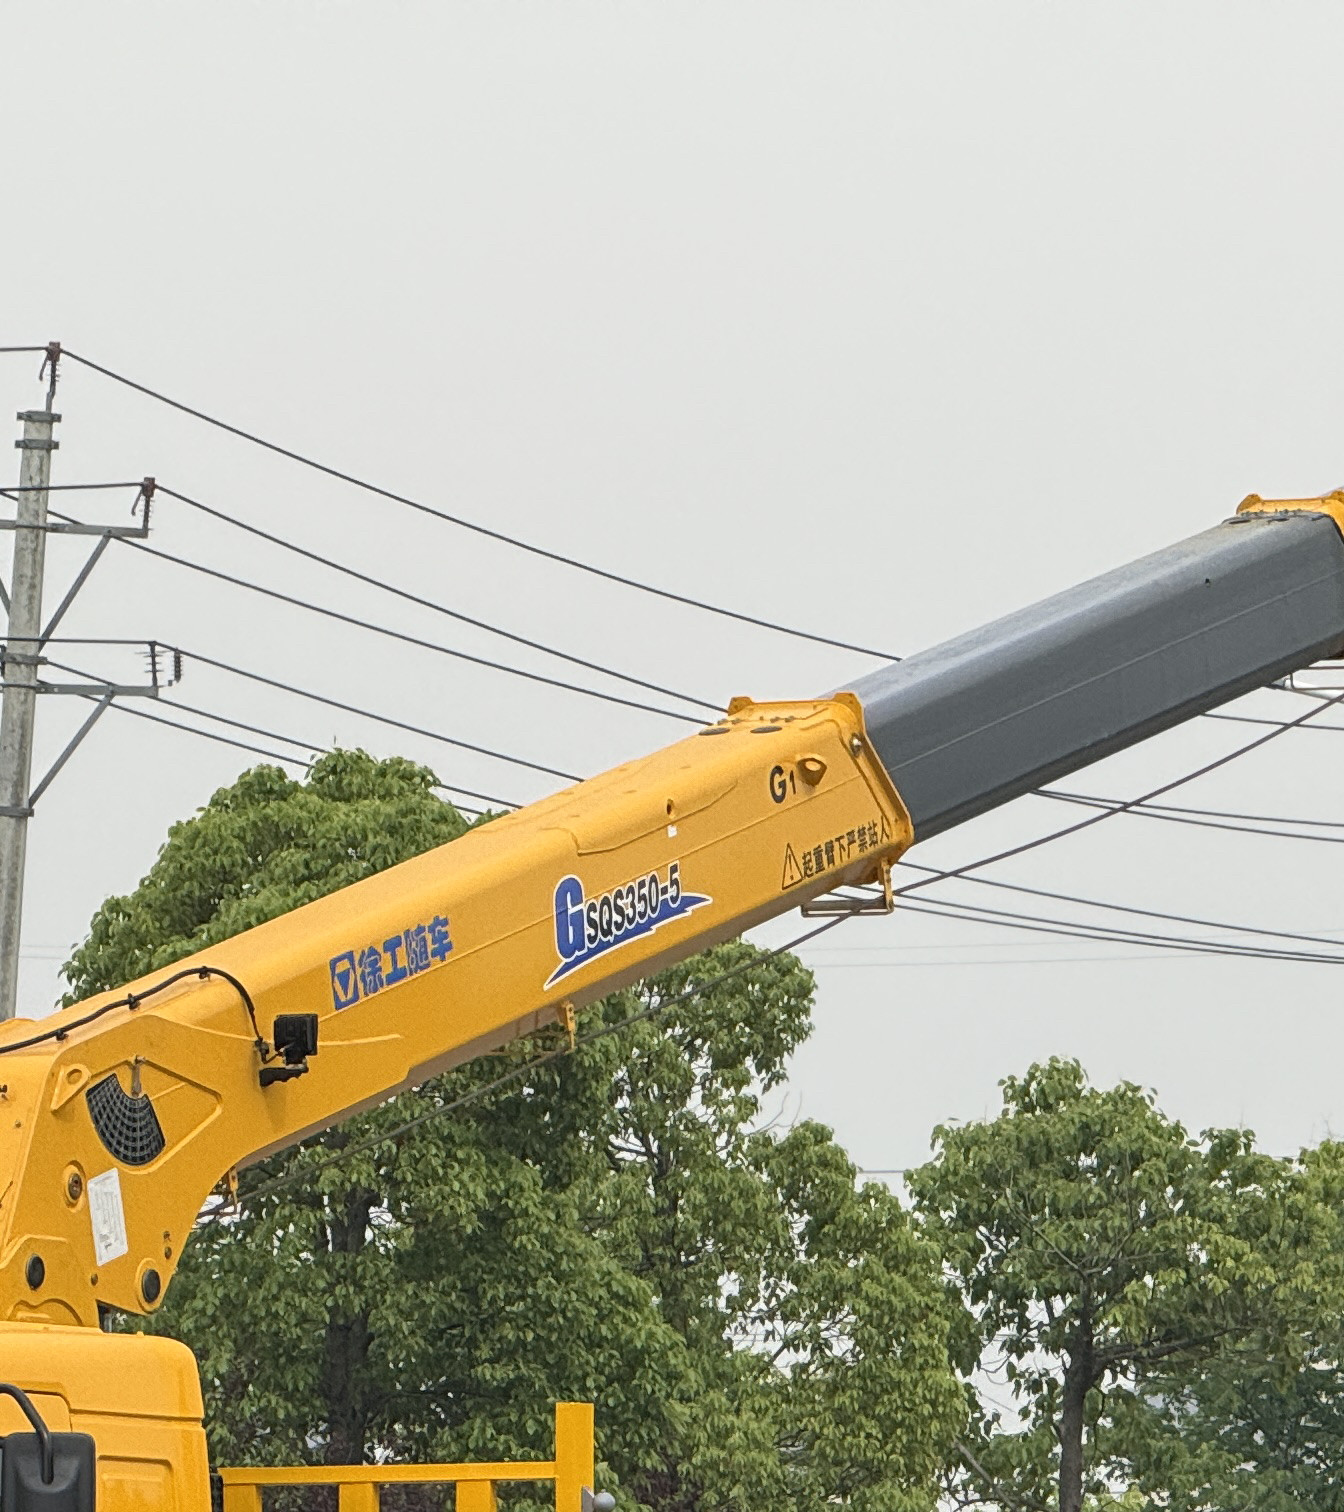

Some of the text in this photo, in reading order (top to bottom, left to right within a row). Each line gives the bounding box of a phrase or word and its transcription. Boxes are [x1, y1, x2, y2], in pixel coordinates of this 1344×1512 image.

[770, 765, 796, 804] G1
[802, 815, 890, 879] 起重臂下严禁站人
[554, 861, 682, 961] GSQS350-5
[358, 915, 453, 997] 徐工随车
